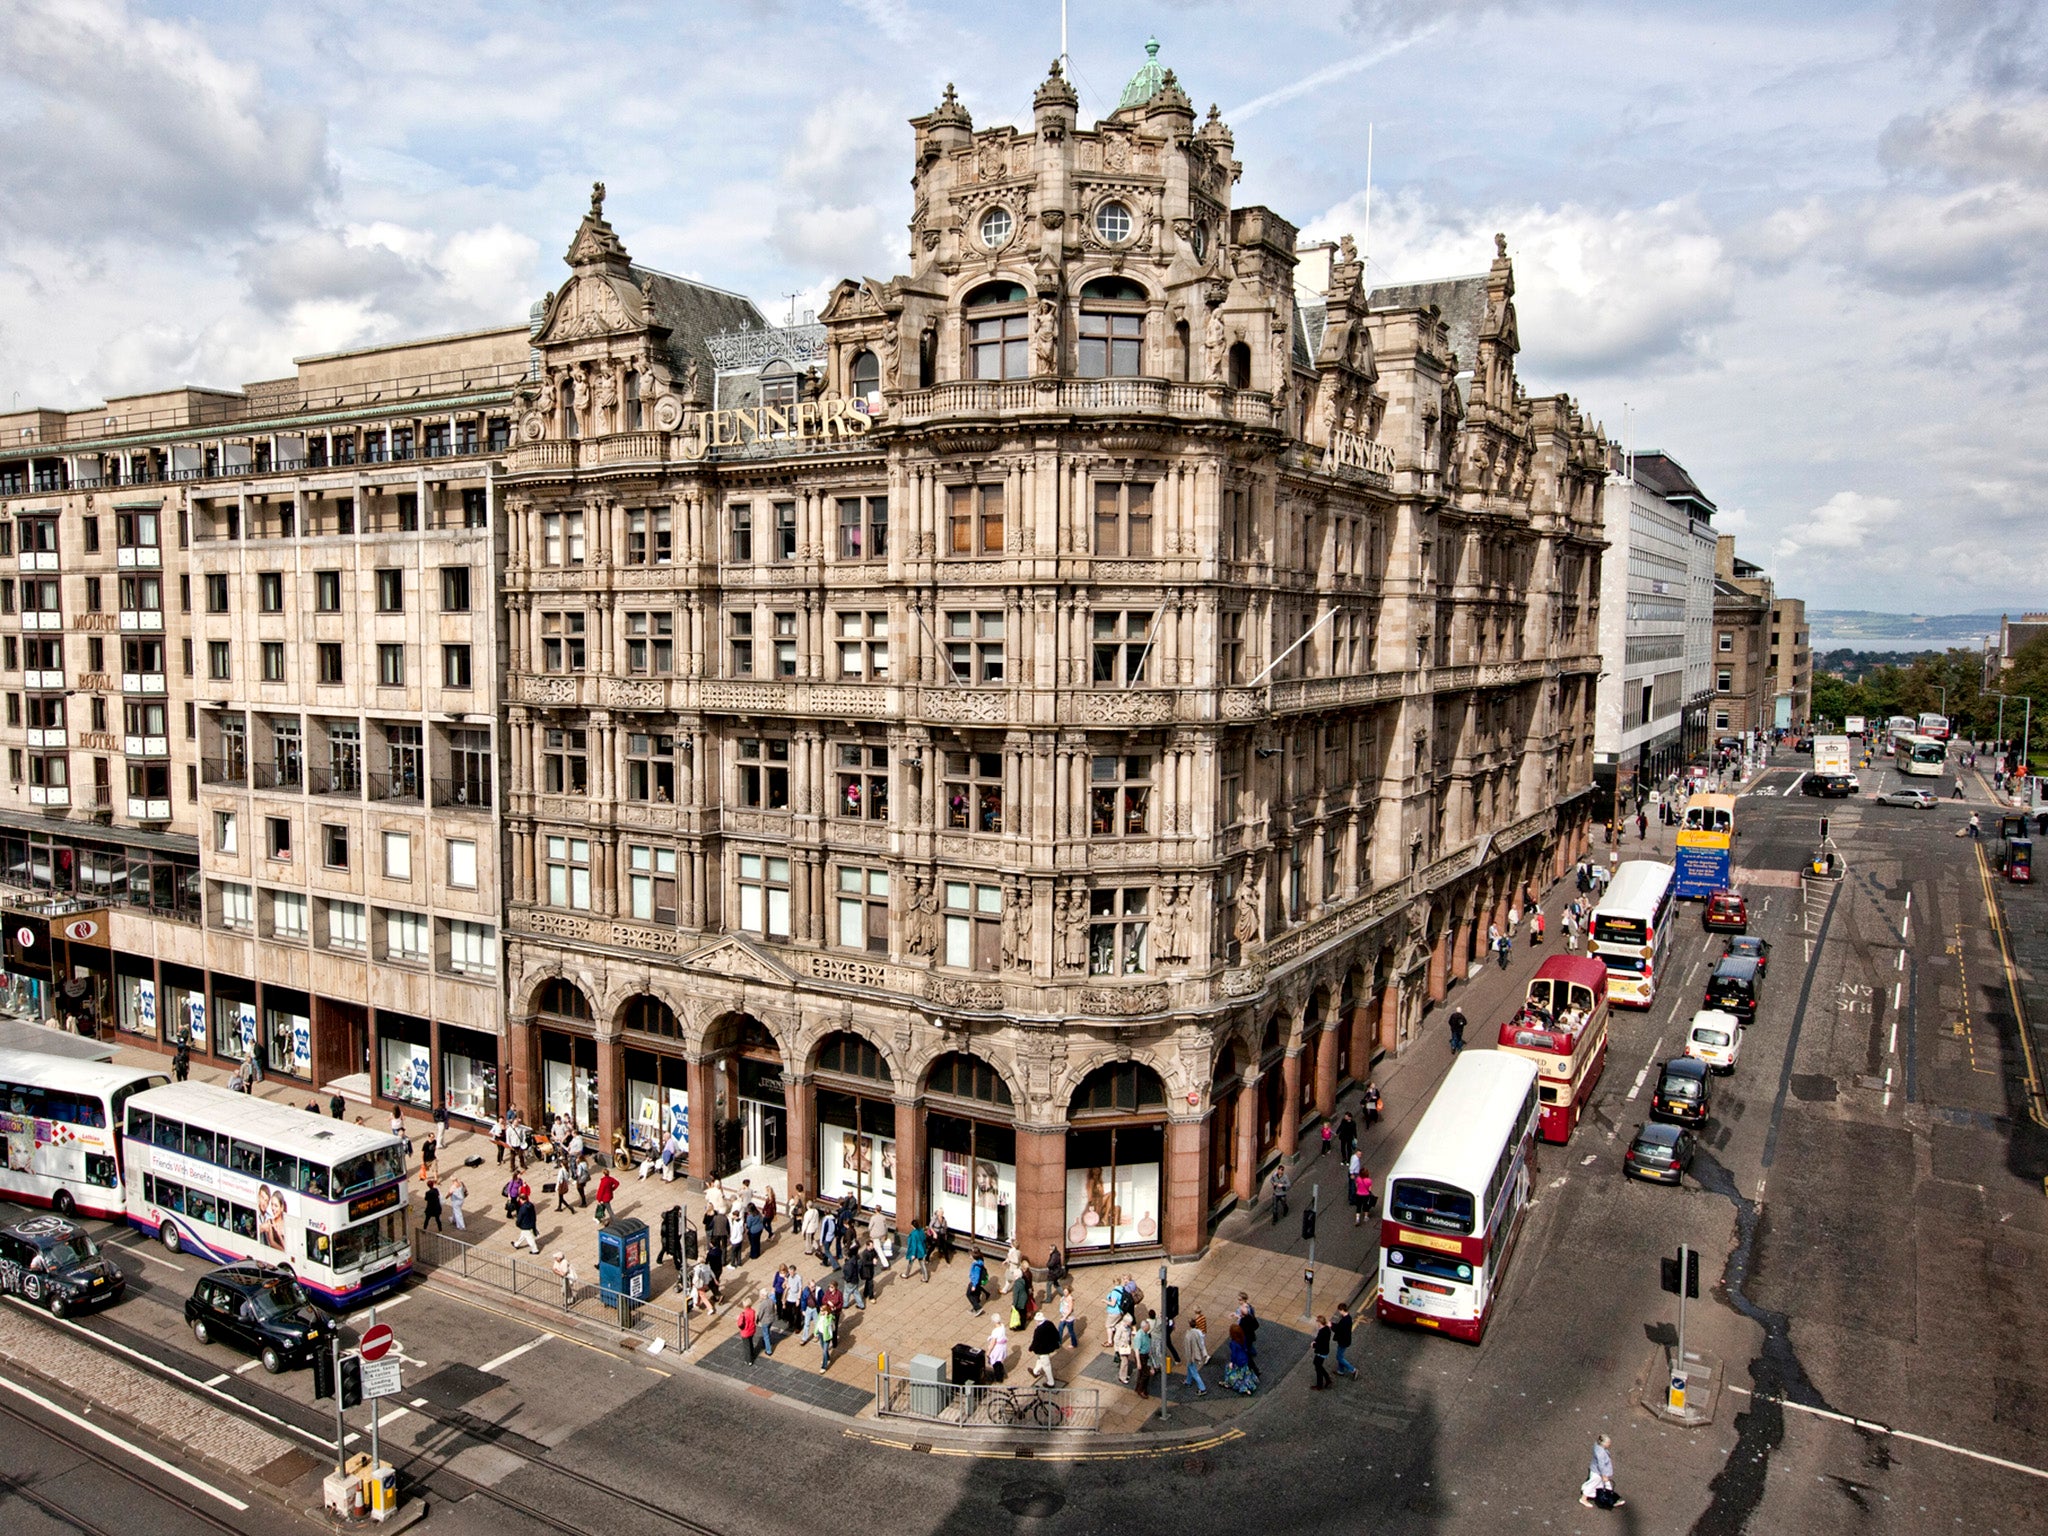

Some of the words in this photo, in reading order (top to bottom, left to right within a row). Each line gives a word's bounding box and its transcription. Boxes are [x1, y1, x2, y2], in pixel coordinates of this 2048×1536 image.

[684, 396, 872, 460] JENNERS
[1327, 429, 1396, 476] JENNERS
[73, 614, 117, 630] MOUNT
[78, 673, 114, 690] ROYAL
[79, 732, 119, 751] HOTEL
[1405, 1211, 1412, 1220] 8
[1425, 1215, 1460, 1229] Muirhouse
